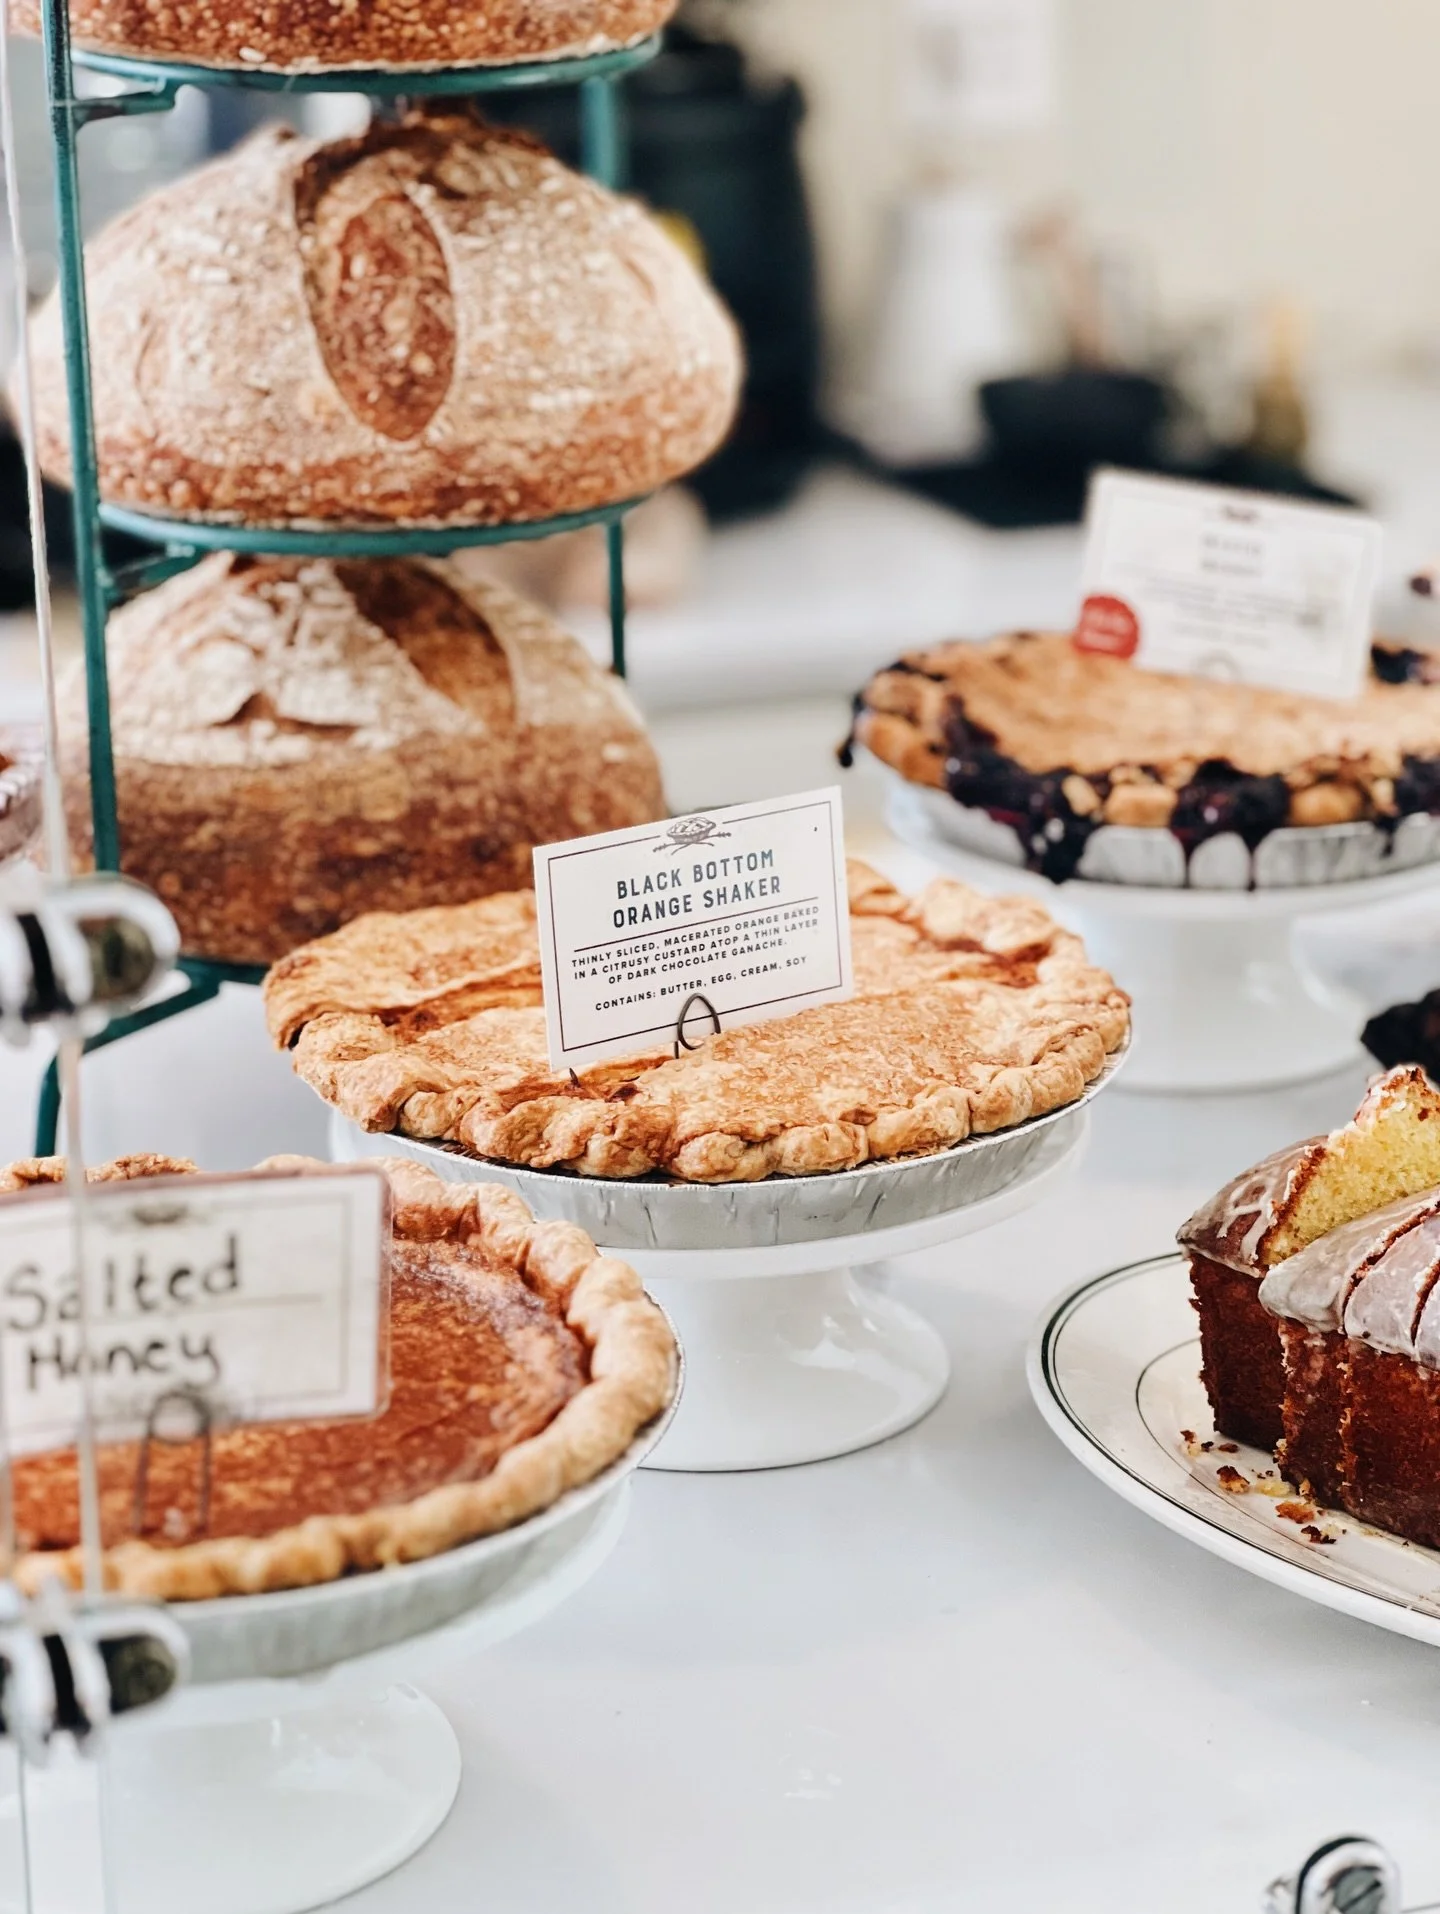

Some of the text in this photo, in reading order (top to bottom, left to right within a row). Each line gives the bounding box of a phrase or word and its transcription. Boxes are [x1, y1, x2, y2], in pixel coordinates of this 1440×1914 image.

[617, 849, 774, 900] BLACK BOTTOM
[613, 876, 781, 928] ORANGE SHAKER
[571, 905, 819, 968] THINLY SLICED, MACERATED ORANGE BAKED
[574, 919, 818, 980] IN A CITRUSY CUSTARD ATOP A THIN LAYER
[608, 938, 787, 984] OF DARK CHOCOLATE GANACHE.
[595, 956, 807, 1011] CONTAINS: BUTTER, EGG, CREAM, SOY
